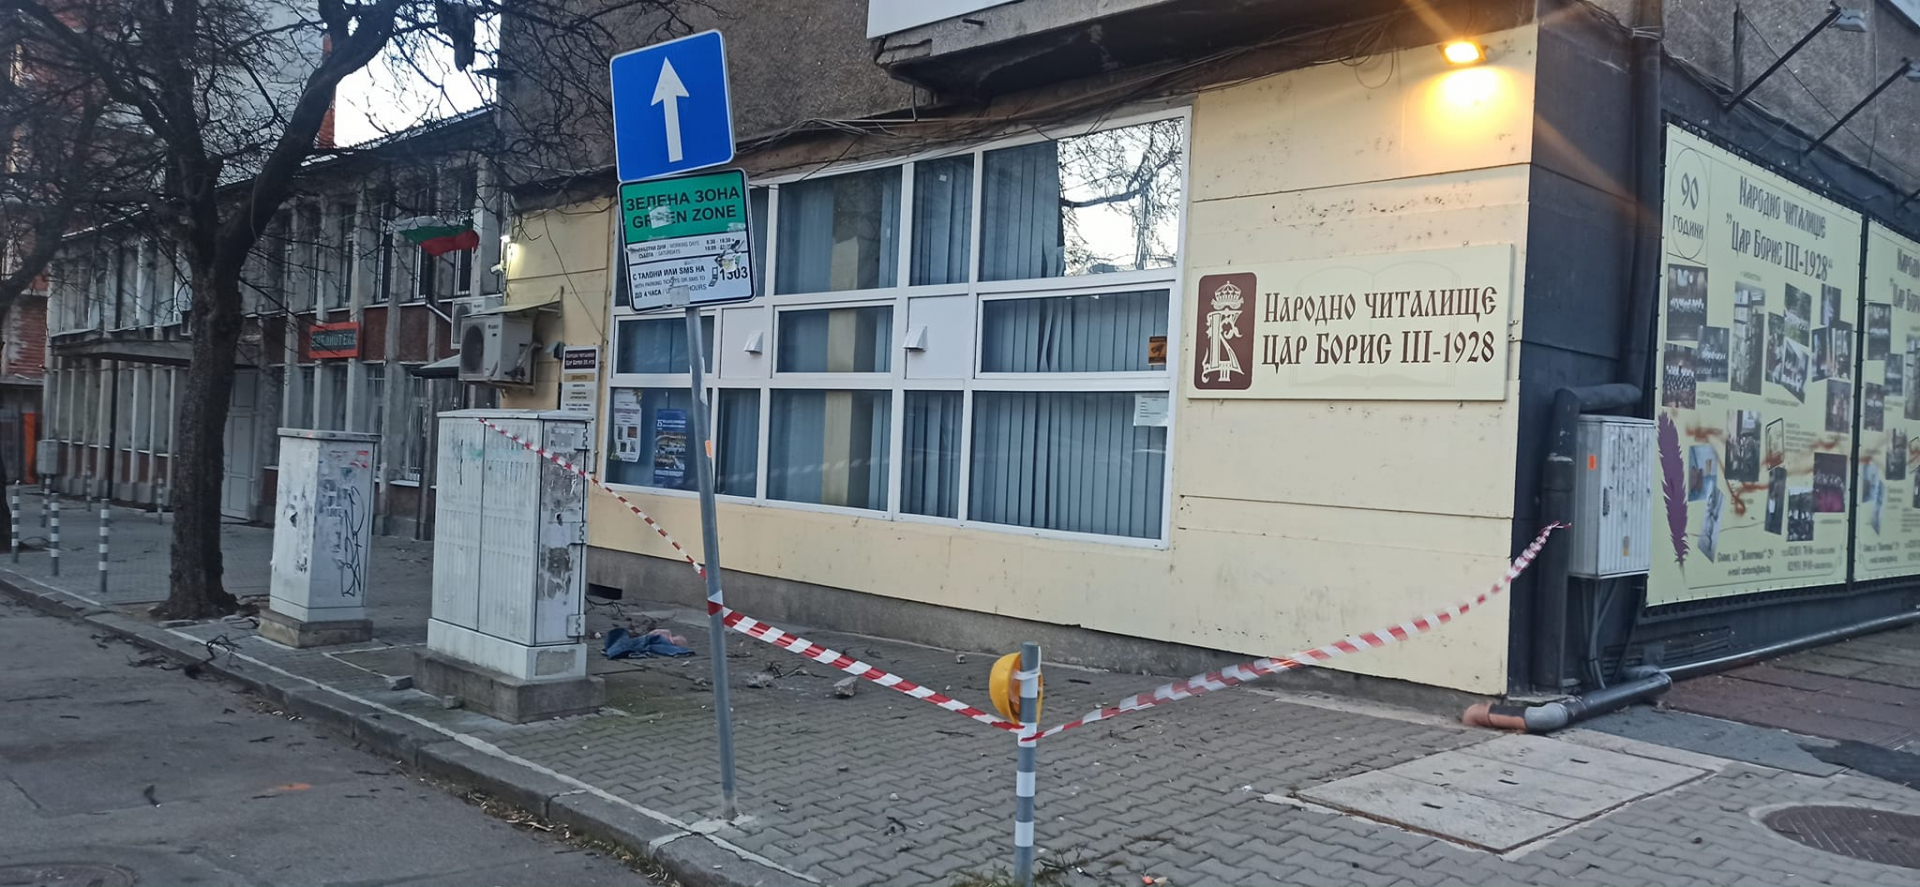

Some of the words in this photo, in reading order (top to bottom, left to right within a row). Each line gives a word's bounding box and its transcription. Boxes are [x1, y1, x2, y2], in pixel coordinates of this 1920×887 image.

[626, 191, 690, 212] ЗЕЛЕНА
[694, 186, 740, 203] ЗОНА
[1681, 172, 1699, 211] 90
[692, 204, 737, 221] ZONE
[638, 269, 663, 280] ТАЛОНИ
[664, 268, 678, 276] ИЛИ
[679, 266, 694, 275] SMS
[635, 291, 643, 299] ДО
[1400, 330, 1495, 363] III-1928
